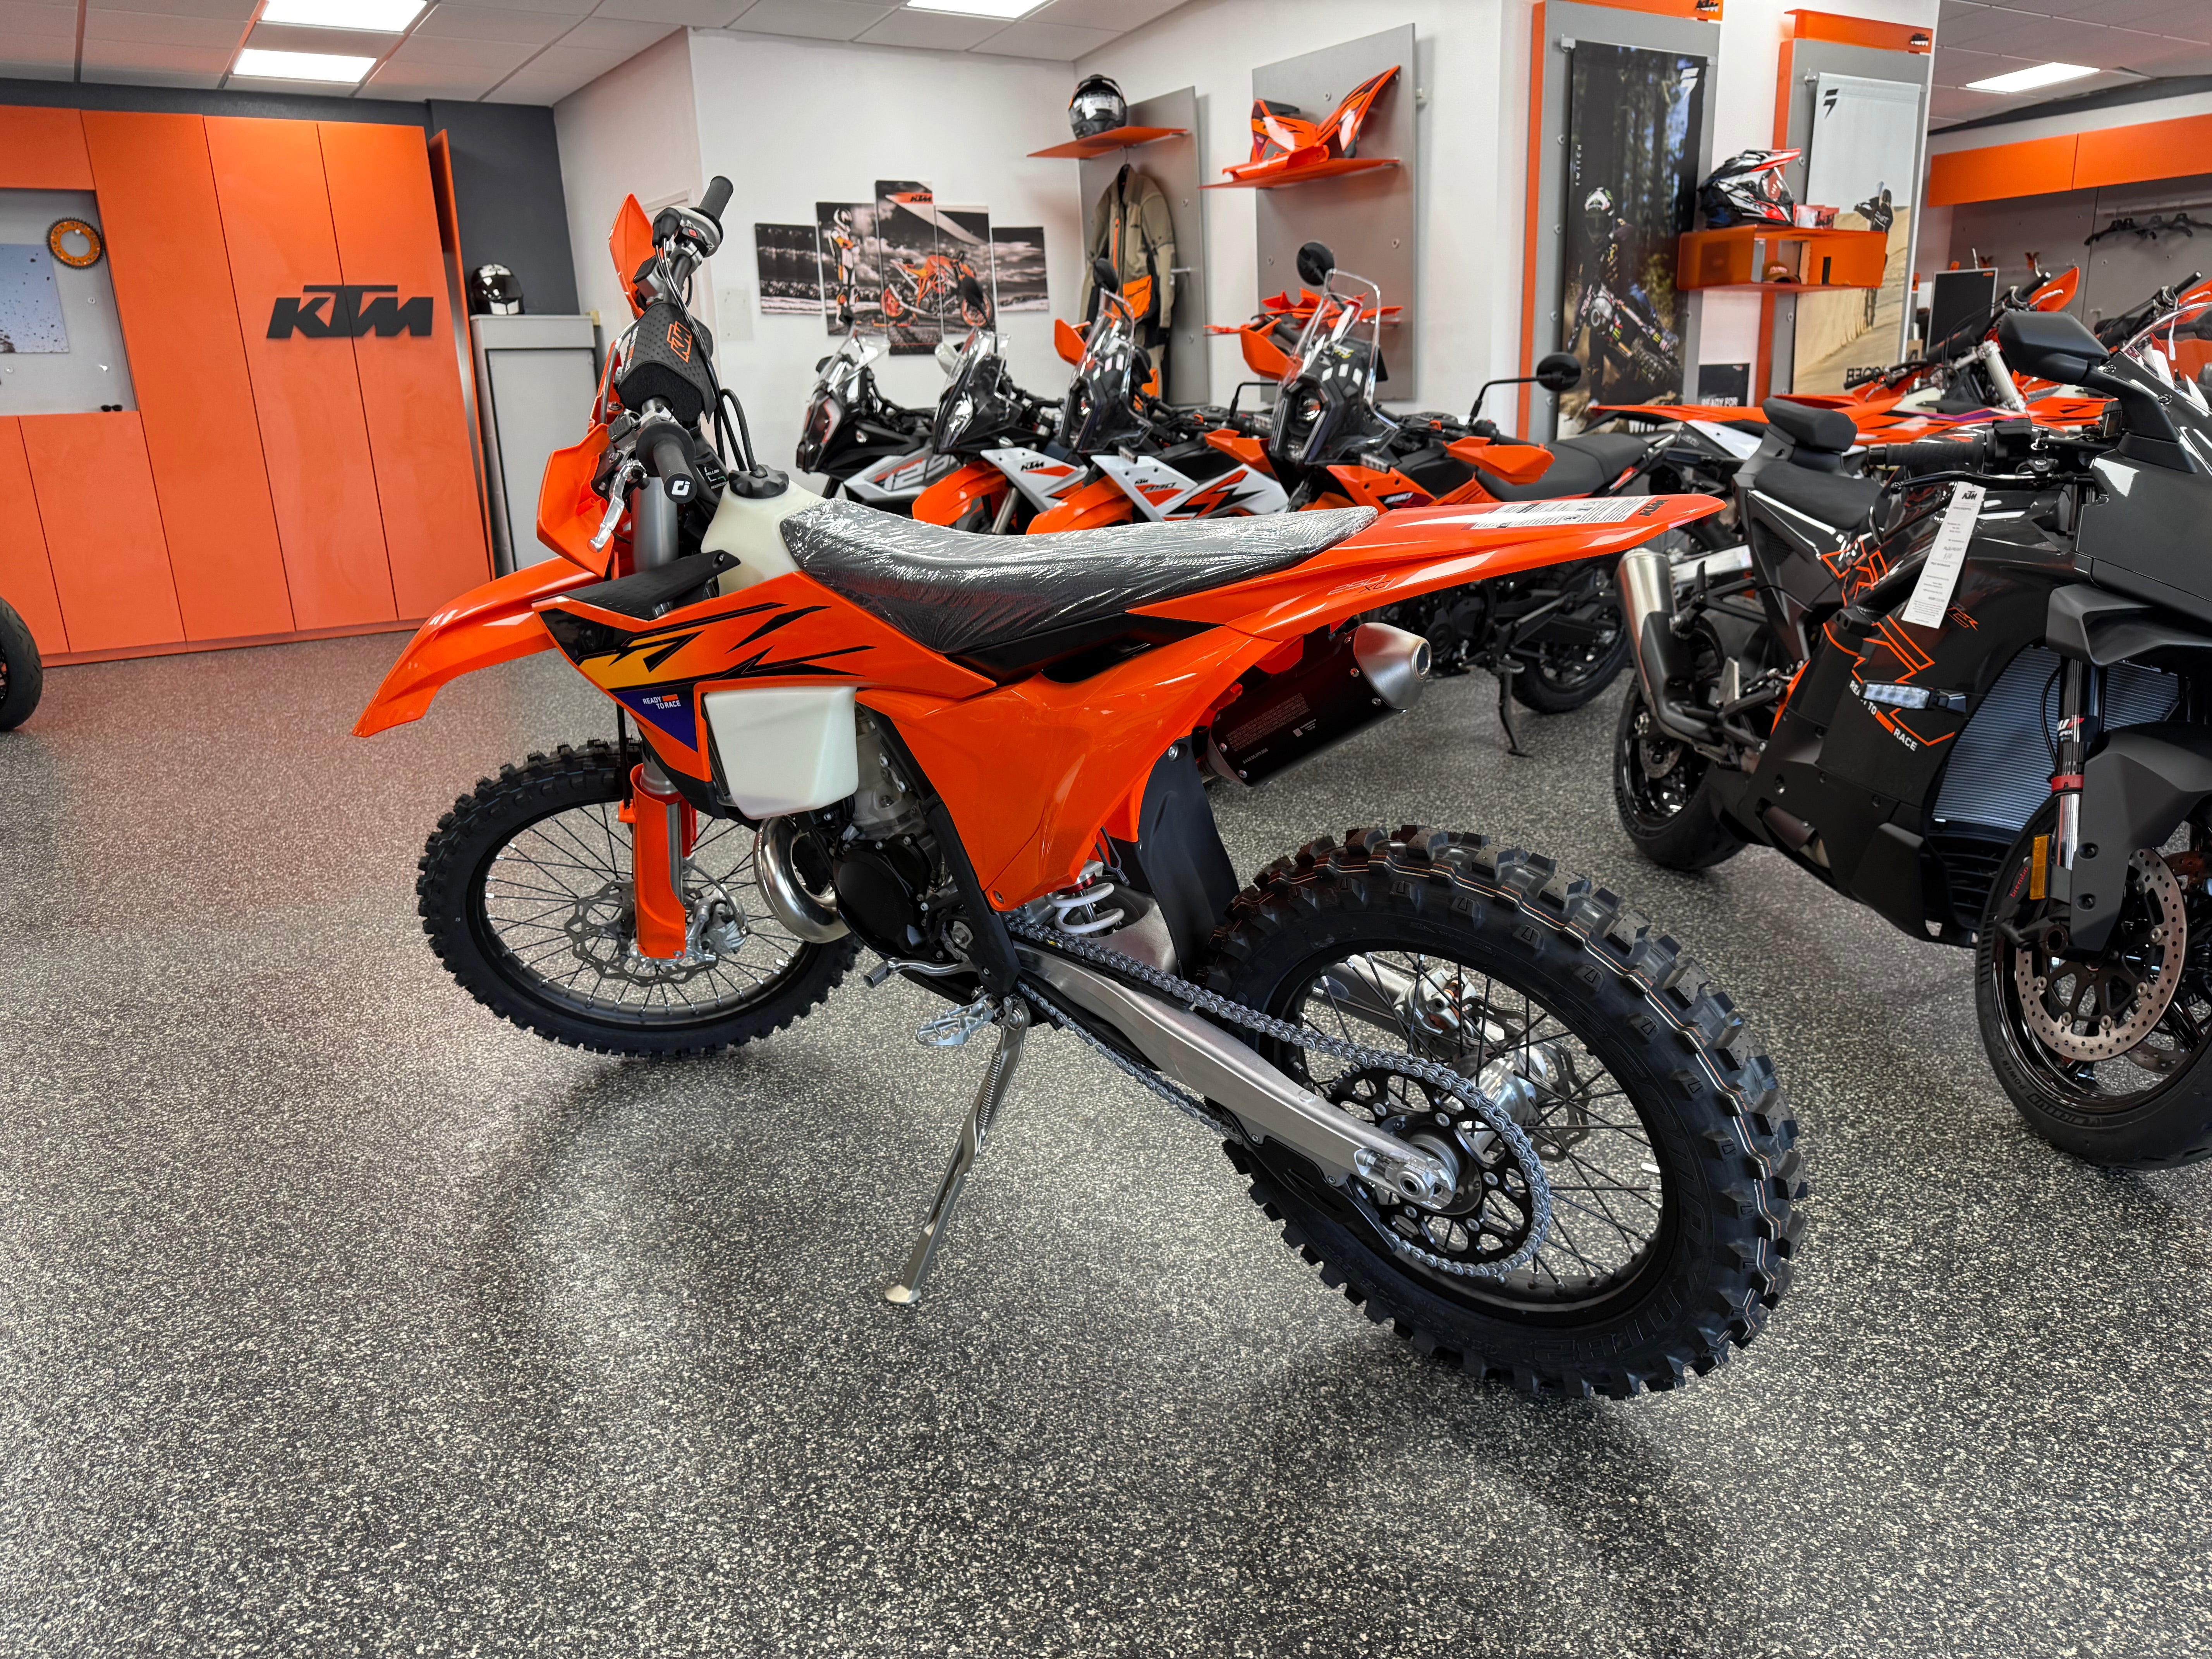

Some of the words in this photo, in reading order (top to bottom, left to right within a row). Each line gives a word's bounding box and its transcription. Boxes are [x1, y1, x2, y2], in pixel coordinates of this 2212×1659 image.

[266, 285, 434, 338] KTM
[667, 321, 692, 363] KTM
[1020, 460, 1044, 471] KTM
[1961, 491, 1977, 500] KTM
[1638, 499, 1669, 516] KTM
[1326, 574, 1387, 596] 250
[642, 696, 661, 705] READY
[664, 700, 681, 708] RACE
[1868, 701, 1877, 716] TO
[1893, 728, 1918, 751] RACE
[2010, 867, 2028, 898] brembo
[2001, 1060, 2026, 1090] POWER
